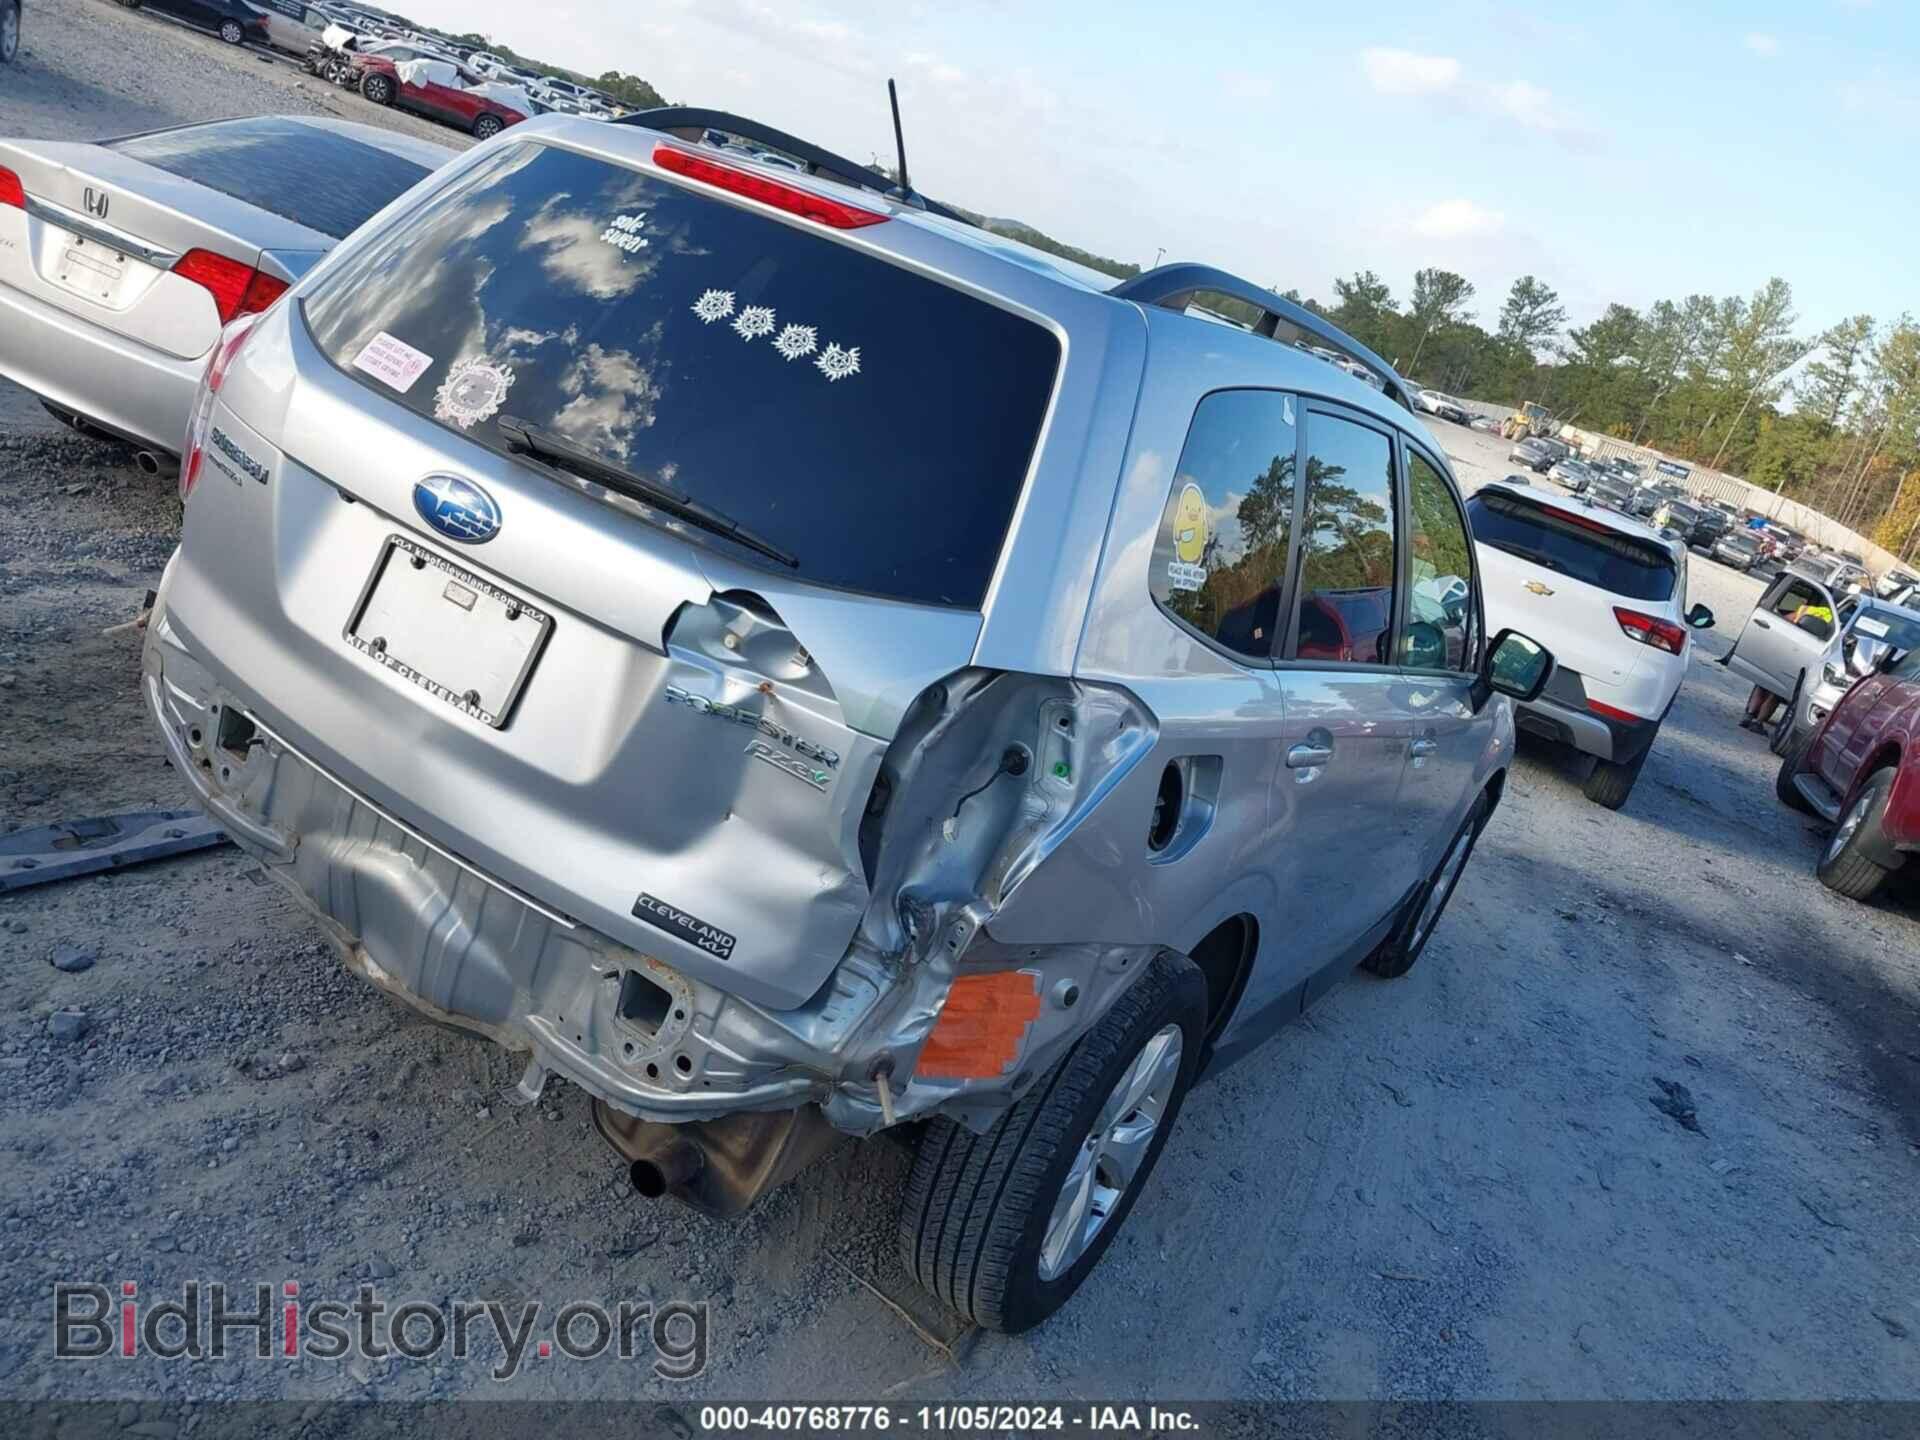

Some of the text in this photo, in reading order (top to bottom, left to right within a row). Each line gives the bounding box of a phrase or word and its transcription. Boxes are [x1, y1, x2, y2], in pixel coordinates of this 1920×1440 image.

[415, 546, 518, 609] kiaofcleveland.com
[346, 634, 492, 725] KIA OF CLEVELAND
[664, 685, 840, 770] FORESTER
[639, 896, 733, 948] CLEVELAND
[698, 938, 729, 957] KIA
